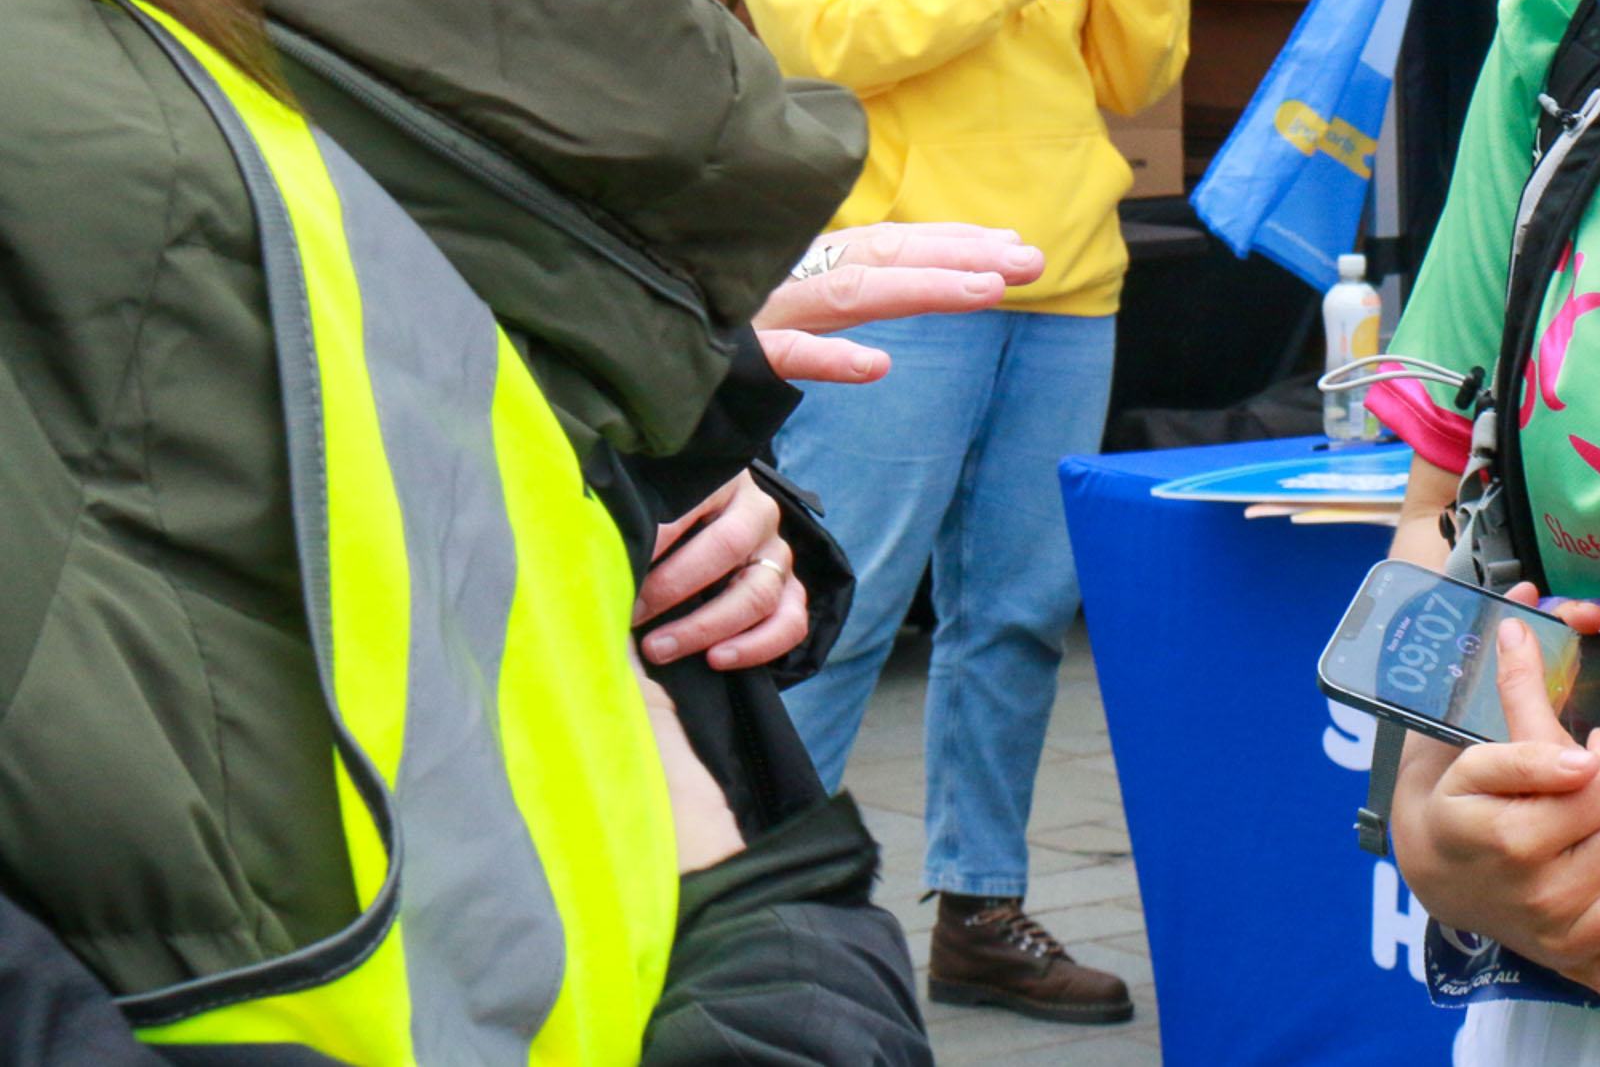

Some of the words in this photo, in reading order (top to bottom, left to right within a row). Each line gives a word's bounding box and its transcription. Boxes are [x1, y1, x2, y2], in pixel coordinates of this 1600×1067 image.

[1386, 591, 1464, 694] 09:07
[1472, 972, 1493, 988] OR
[1493, 970, 1521, 984] ALL
